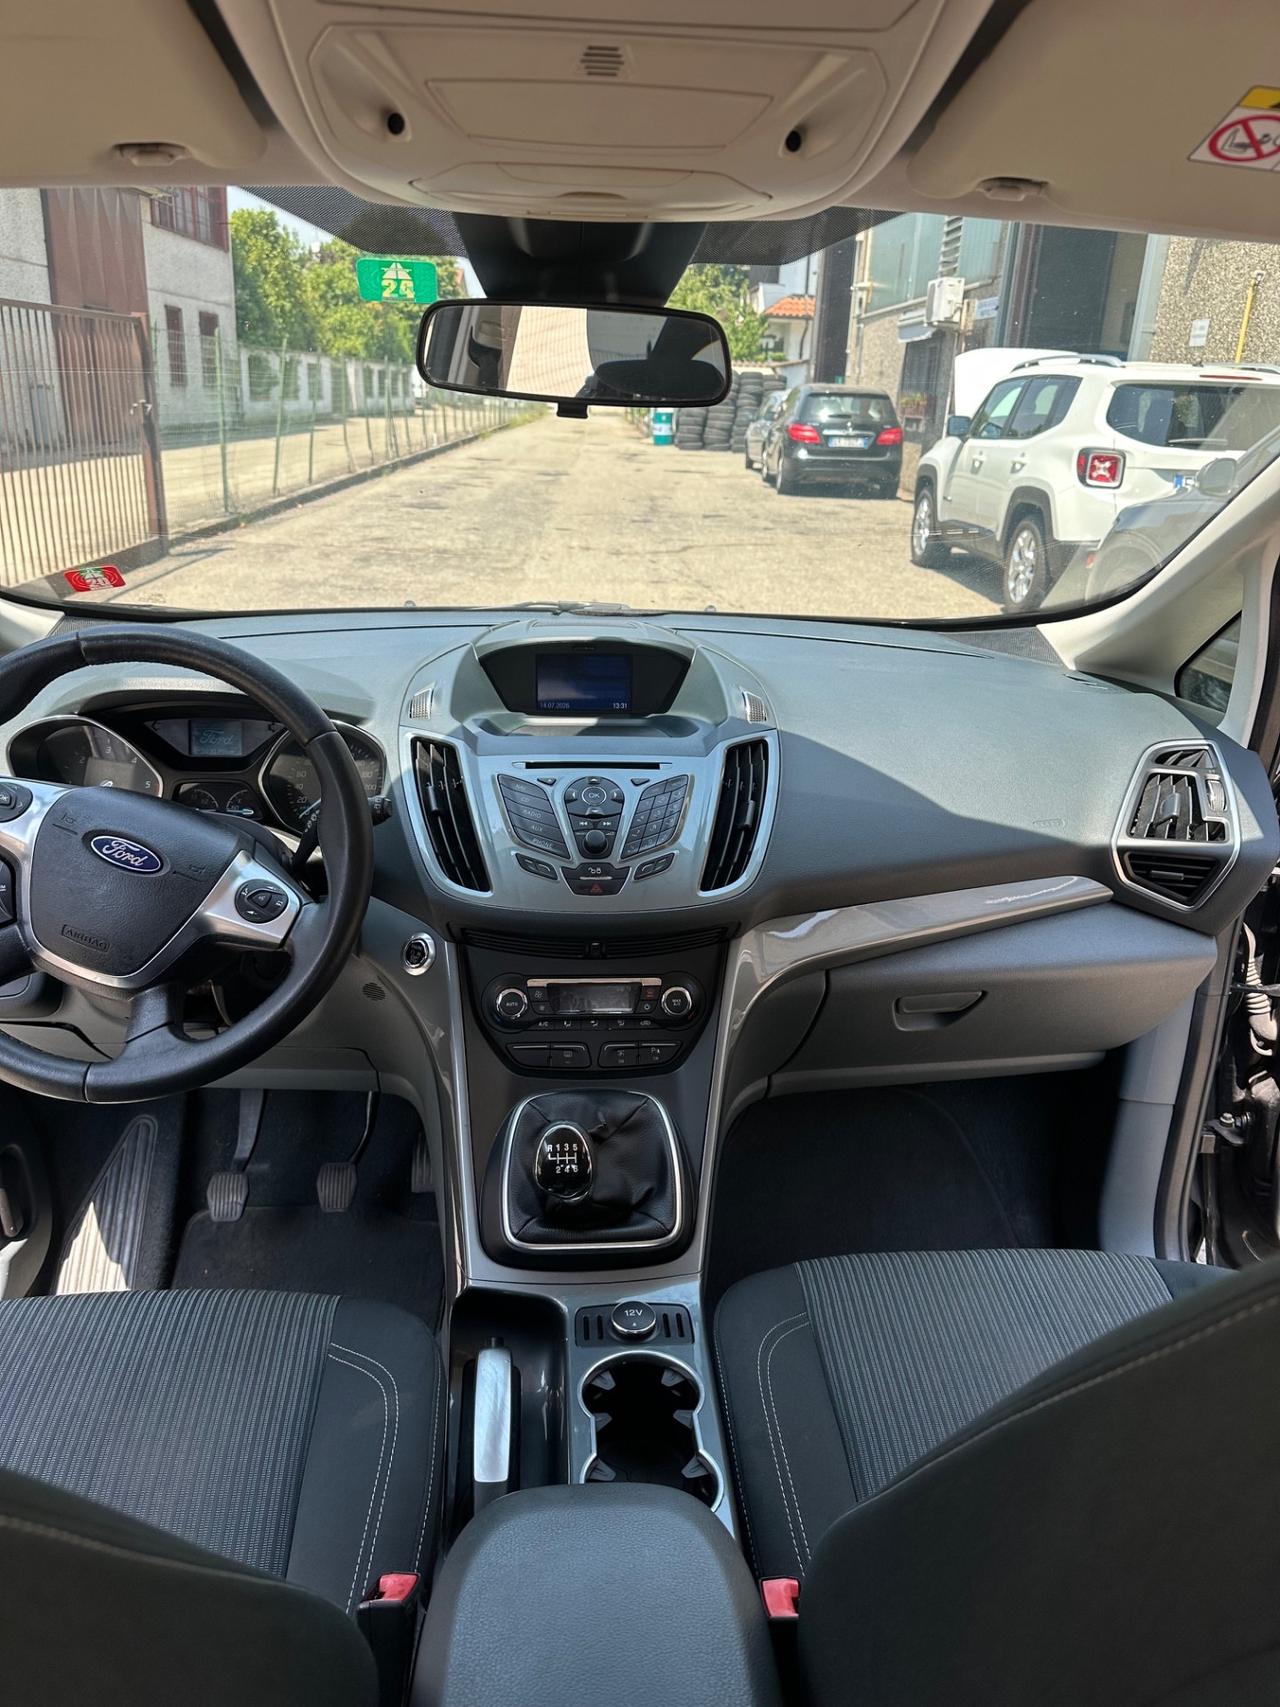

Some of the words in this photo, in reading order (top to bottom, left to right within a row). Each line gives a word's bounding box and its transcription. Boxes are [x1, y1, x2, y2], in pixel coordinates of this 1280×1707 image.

[200, 729, 234, 744] Ford
[145, 780, 151, 788] 5
[102, 840, 148, 867] Ford
[547, 1144, 553, 1152] R
[556, 1143, 561, 1152] 1
[564, 1143, 570, 1151] 3
[572, 1143, 578, 1151] 5
[556, 1165, 562, 1174] 2
[564, 1165, 571, 1173] 4
[624, 1309, 643, 1317] 12V
